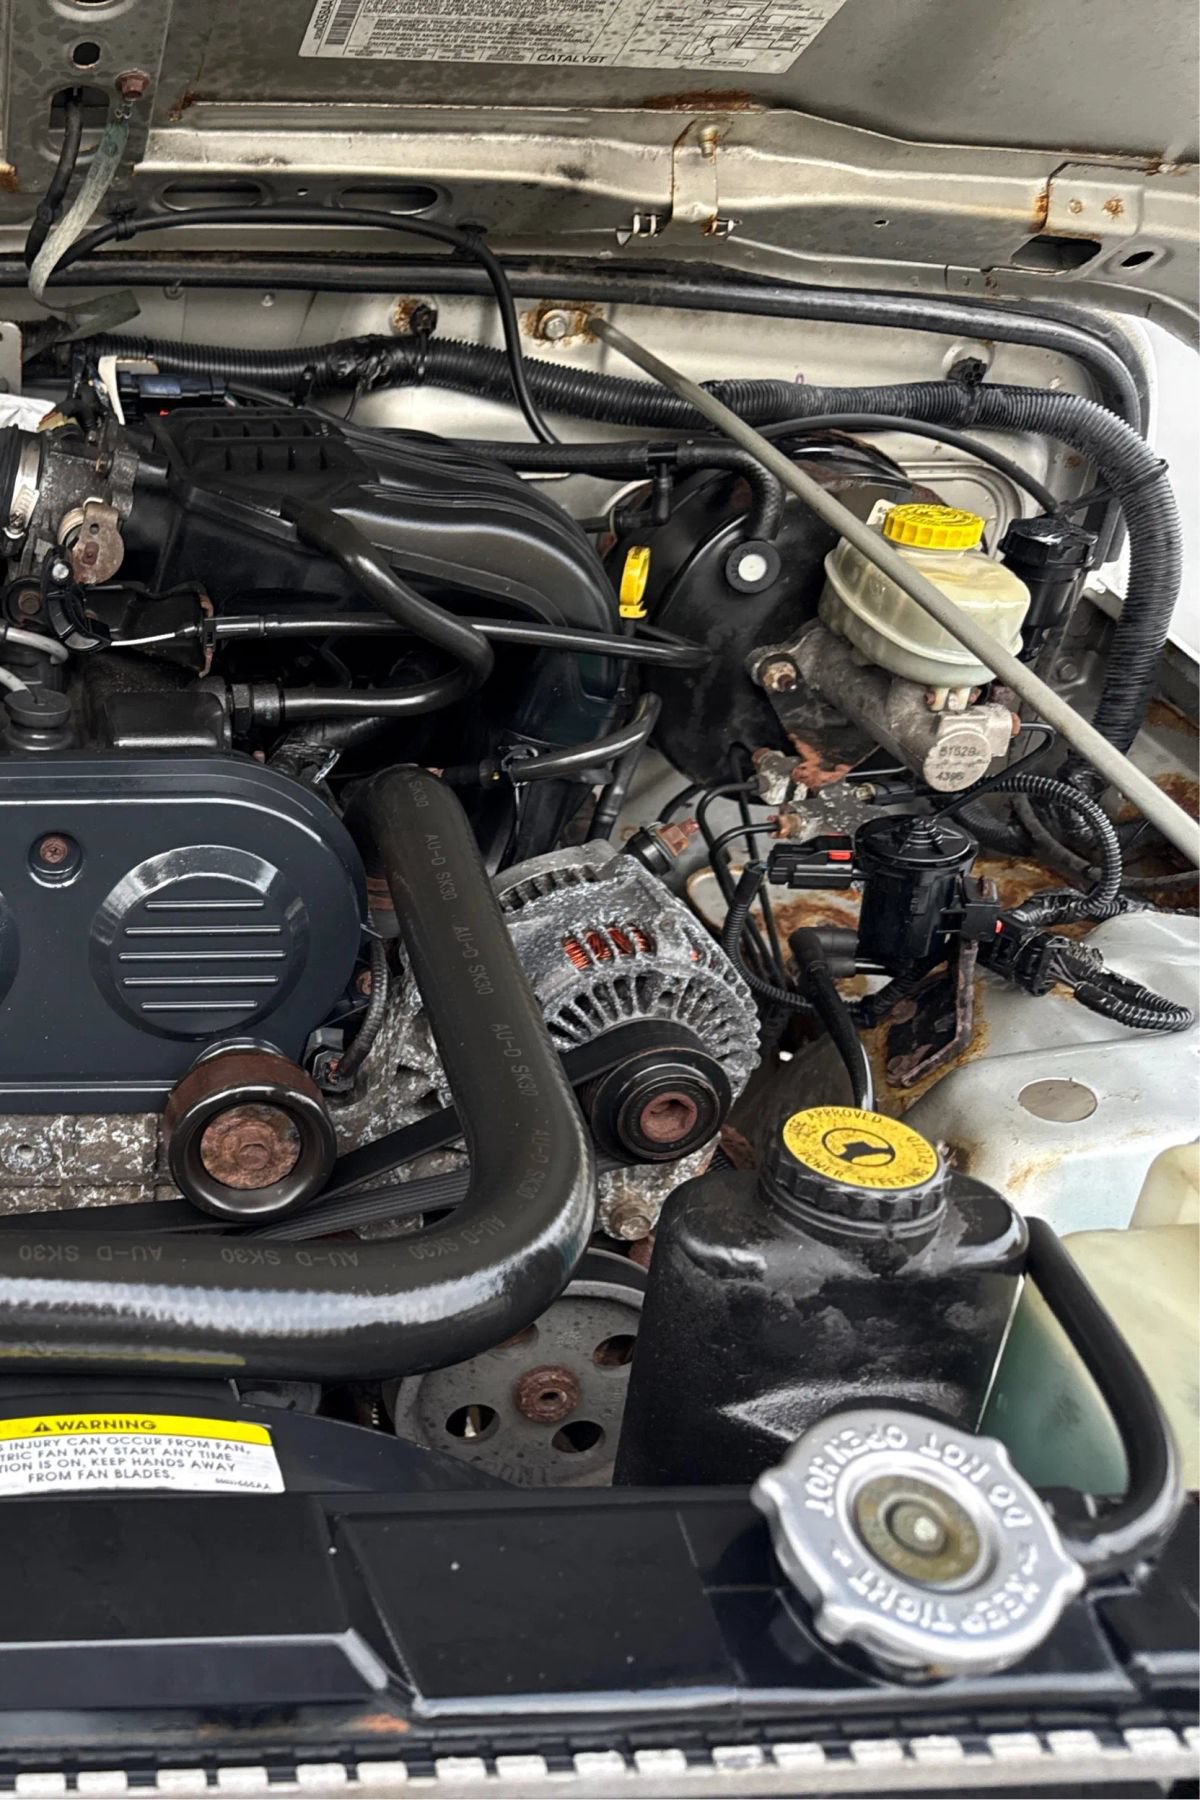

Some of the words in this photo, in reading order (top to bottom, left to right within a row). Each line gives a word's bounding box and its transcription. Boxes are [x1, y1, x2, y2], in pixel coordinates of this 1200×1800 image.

[537, 53, 608, 63] CATALYST
[436, 871, 457, 901] SK30
[468, 964, 494, 995] SK30
[511, 1064, 538, 1097] SK30
[806, 1108, 882, 1124] APPROVED
[800, 1151, 844, 1178] POWER
[19, 1245, 79, 1262] SK30
[96, 1246, 163, 1262] AU-D
[220, 1248, 281, 1266] SK30
[295, 1251, 359, 1267] AU-D
[56, 1419, 157, 1431] WARNING
[9, 1438, 61, 1450] INJURY
[66, 1436, 100, 1446] CAN
[106, 1436, 162, 1446] OCCUR
[167, 1438, 210, 1448] FROM
[823, 1425, 908, 1464] OPEN
[37, 1448, 68, 1459] FAN
[73, 1447, 108, 1456] MAY
[113, 1446, 157, 1455] START
[162, 1448, 192, 1458] ANY
[197, 1450, 232, 1461] TIME
[920, 1433, 990, 1483] NOT
[39, 1459, 51, 1469] IS
[91, 1457, 126, 1467] KEEP
[131, 1457, 185, 1468] HANDS
[191, 1460, 236, 1473] AWAY
[28, 1471, 71, 1484] FROM
[78, 1469, 108, 1480] FAN
[804, 1456, 845, 1518] HOT
[989, 1484, 1033, 1528] DO
[848, 1571, 957, 1632] TIGHT
[961, 1573, 1040, 1634] KEEP
